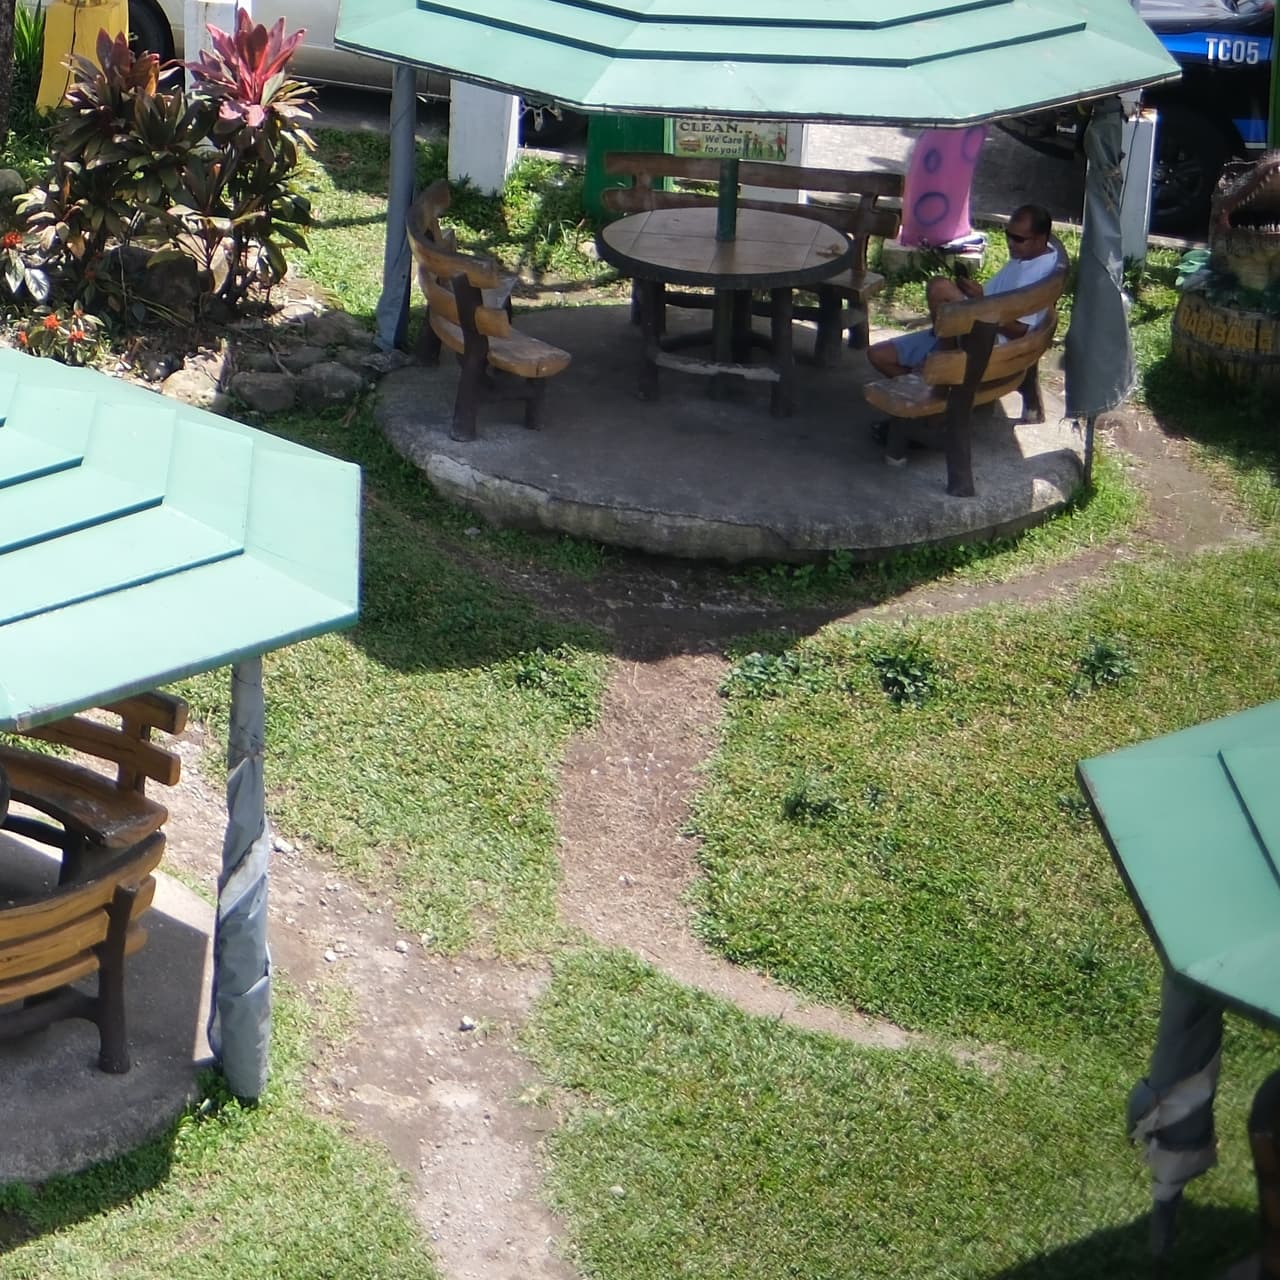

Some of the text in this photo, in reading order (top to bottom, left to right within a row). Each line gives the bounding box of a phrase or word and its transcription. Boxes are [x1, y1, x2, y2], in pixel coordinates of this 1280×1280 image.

[1206, 37, 1259, 65] TC05
[705, 134, 742, 145] We Care
[704, 145, 719, 153] for
